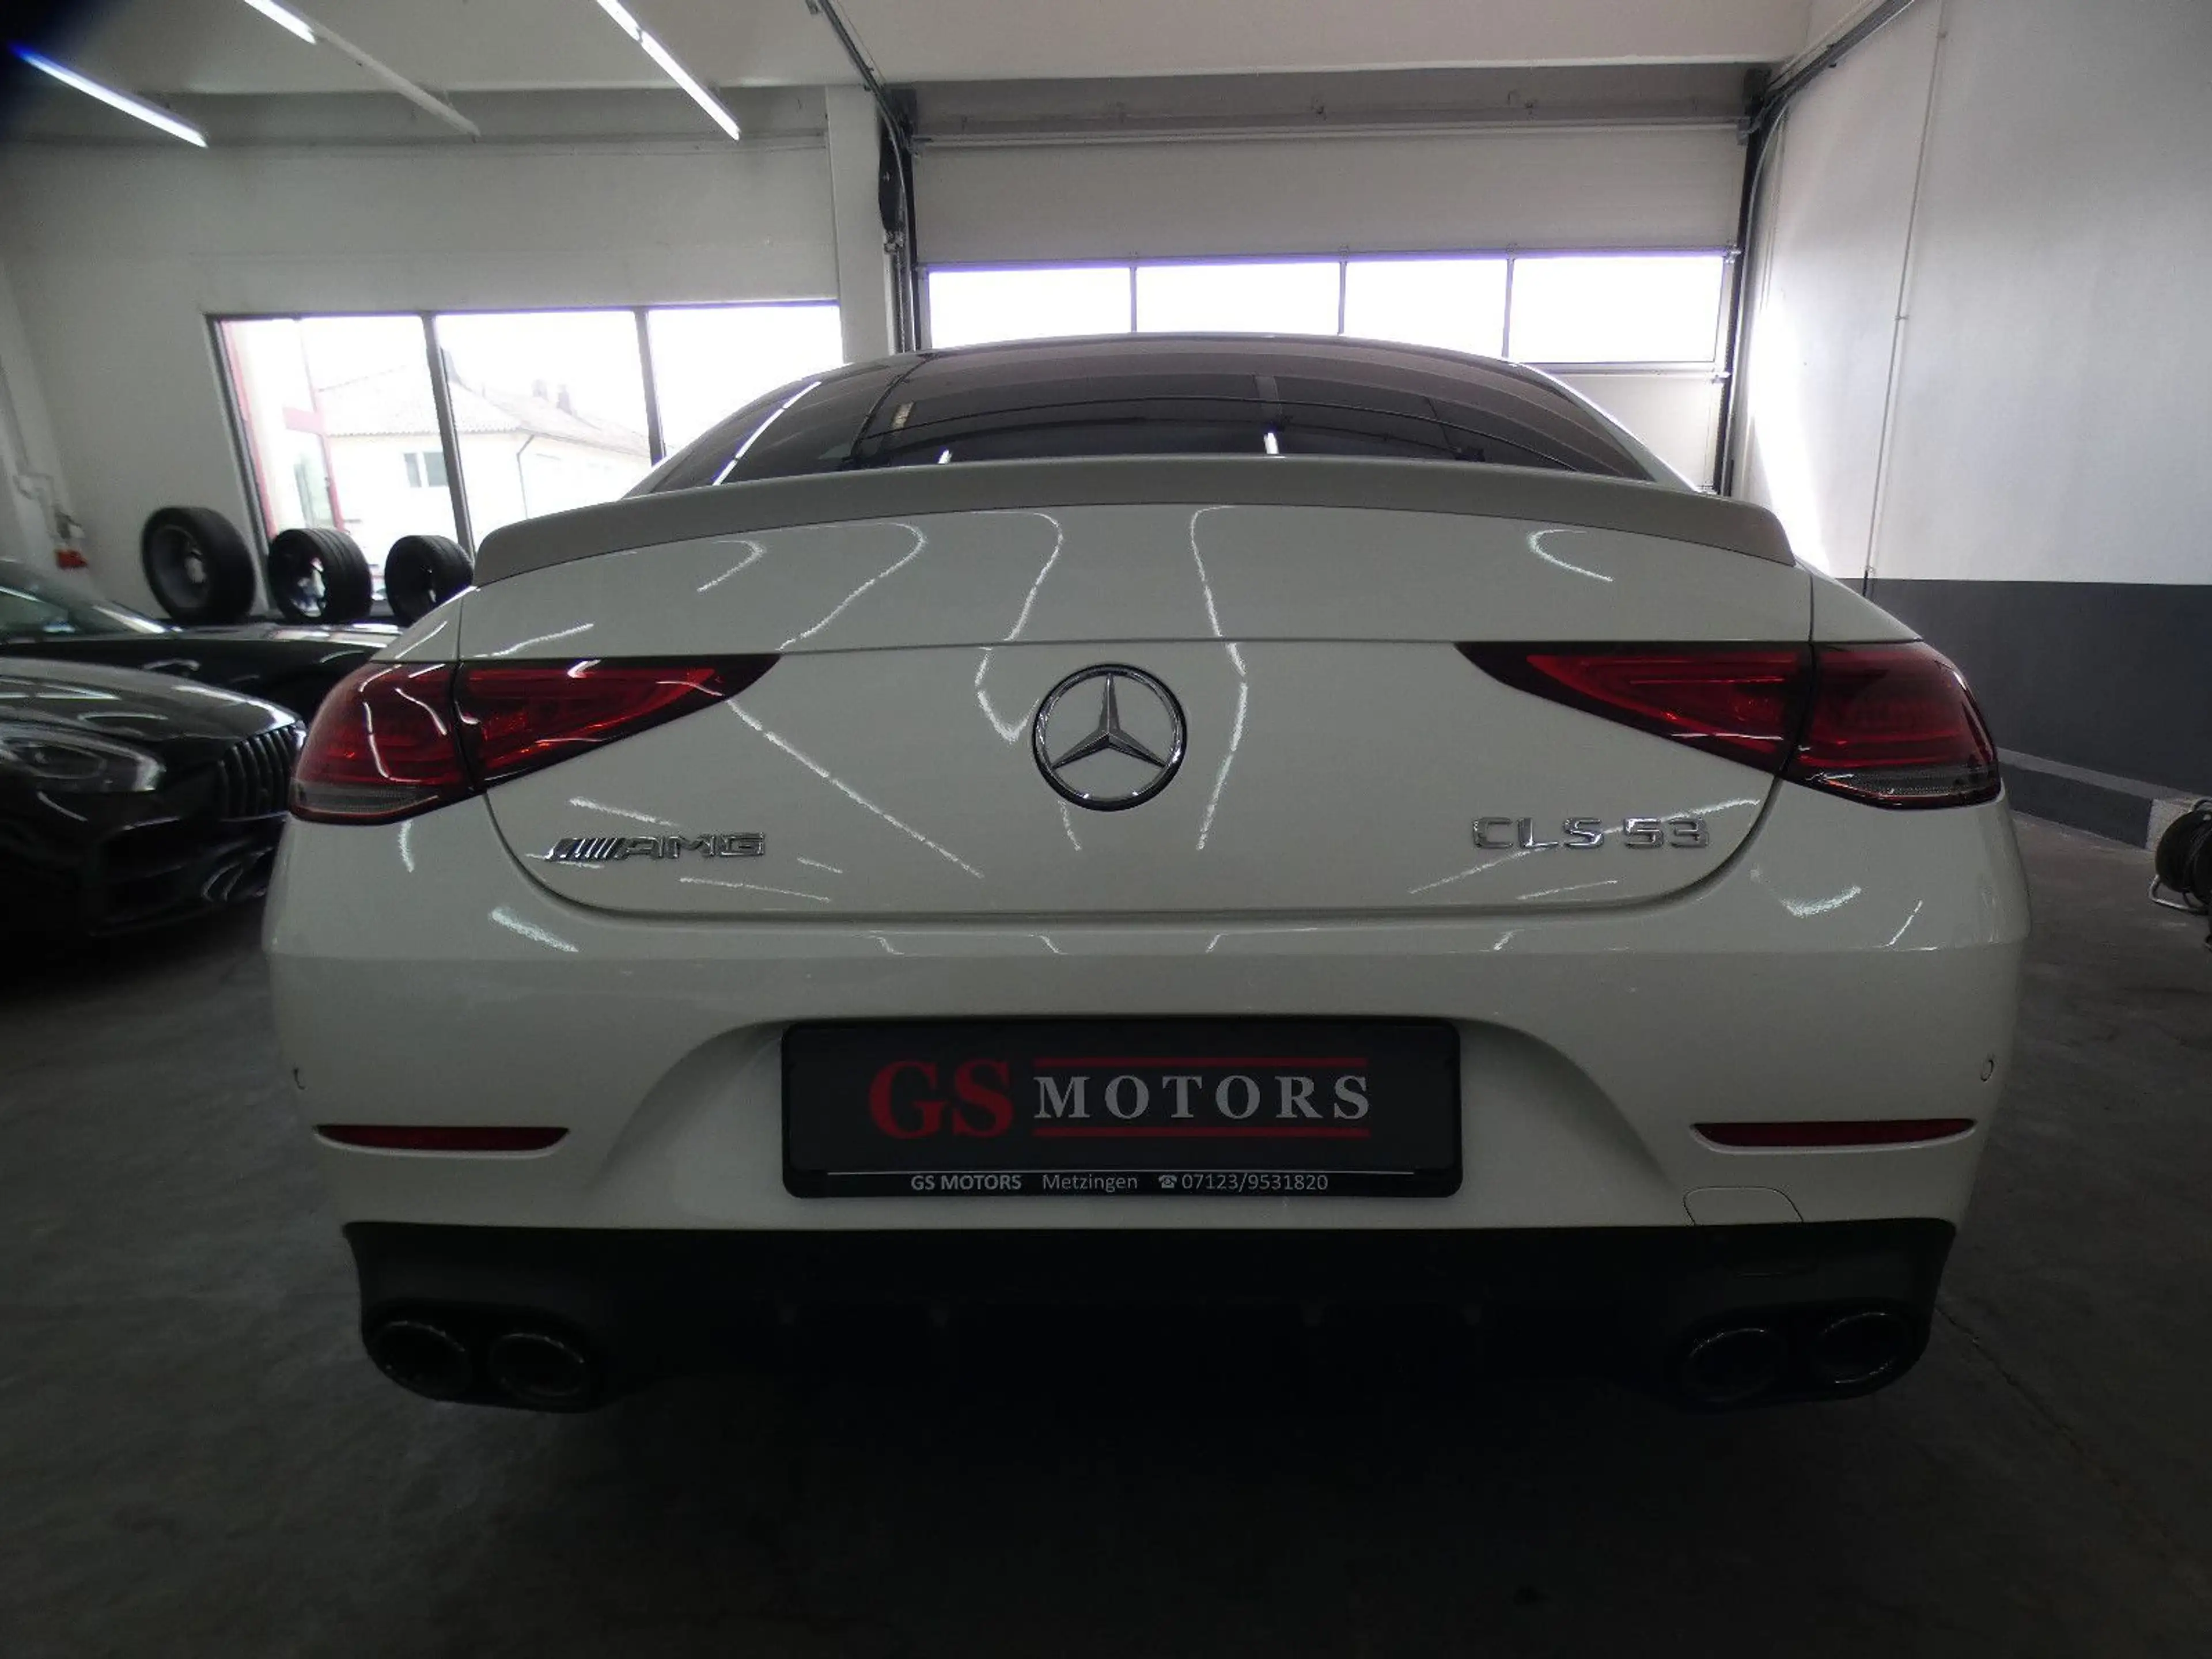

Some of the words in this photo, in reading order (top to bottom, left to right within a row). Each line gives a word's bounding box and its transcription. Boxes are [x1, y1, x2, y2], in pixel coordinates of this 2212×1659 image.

[613, 831, 766, 861] AMG
[1472, 817, 1605, 849] CLS
[1622, 816, 1710, 848] 53
[870, 1060, 1013, 1138] GS
[1033, 1075, 1369, 1119] MOTORS
[910, 1174, 935, 1190] GS
[940, 1174, 1022, 1190] MOTORS
[1042, 1173, 1138, 1192] Metzingen
[1181, 1173, 1328, 1192] 07123/9531820
